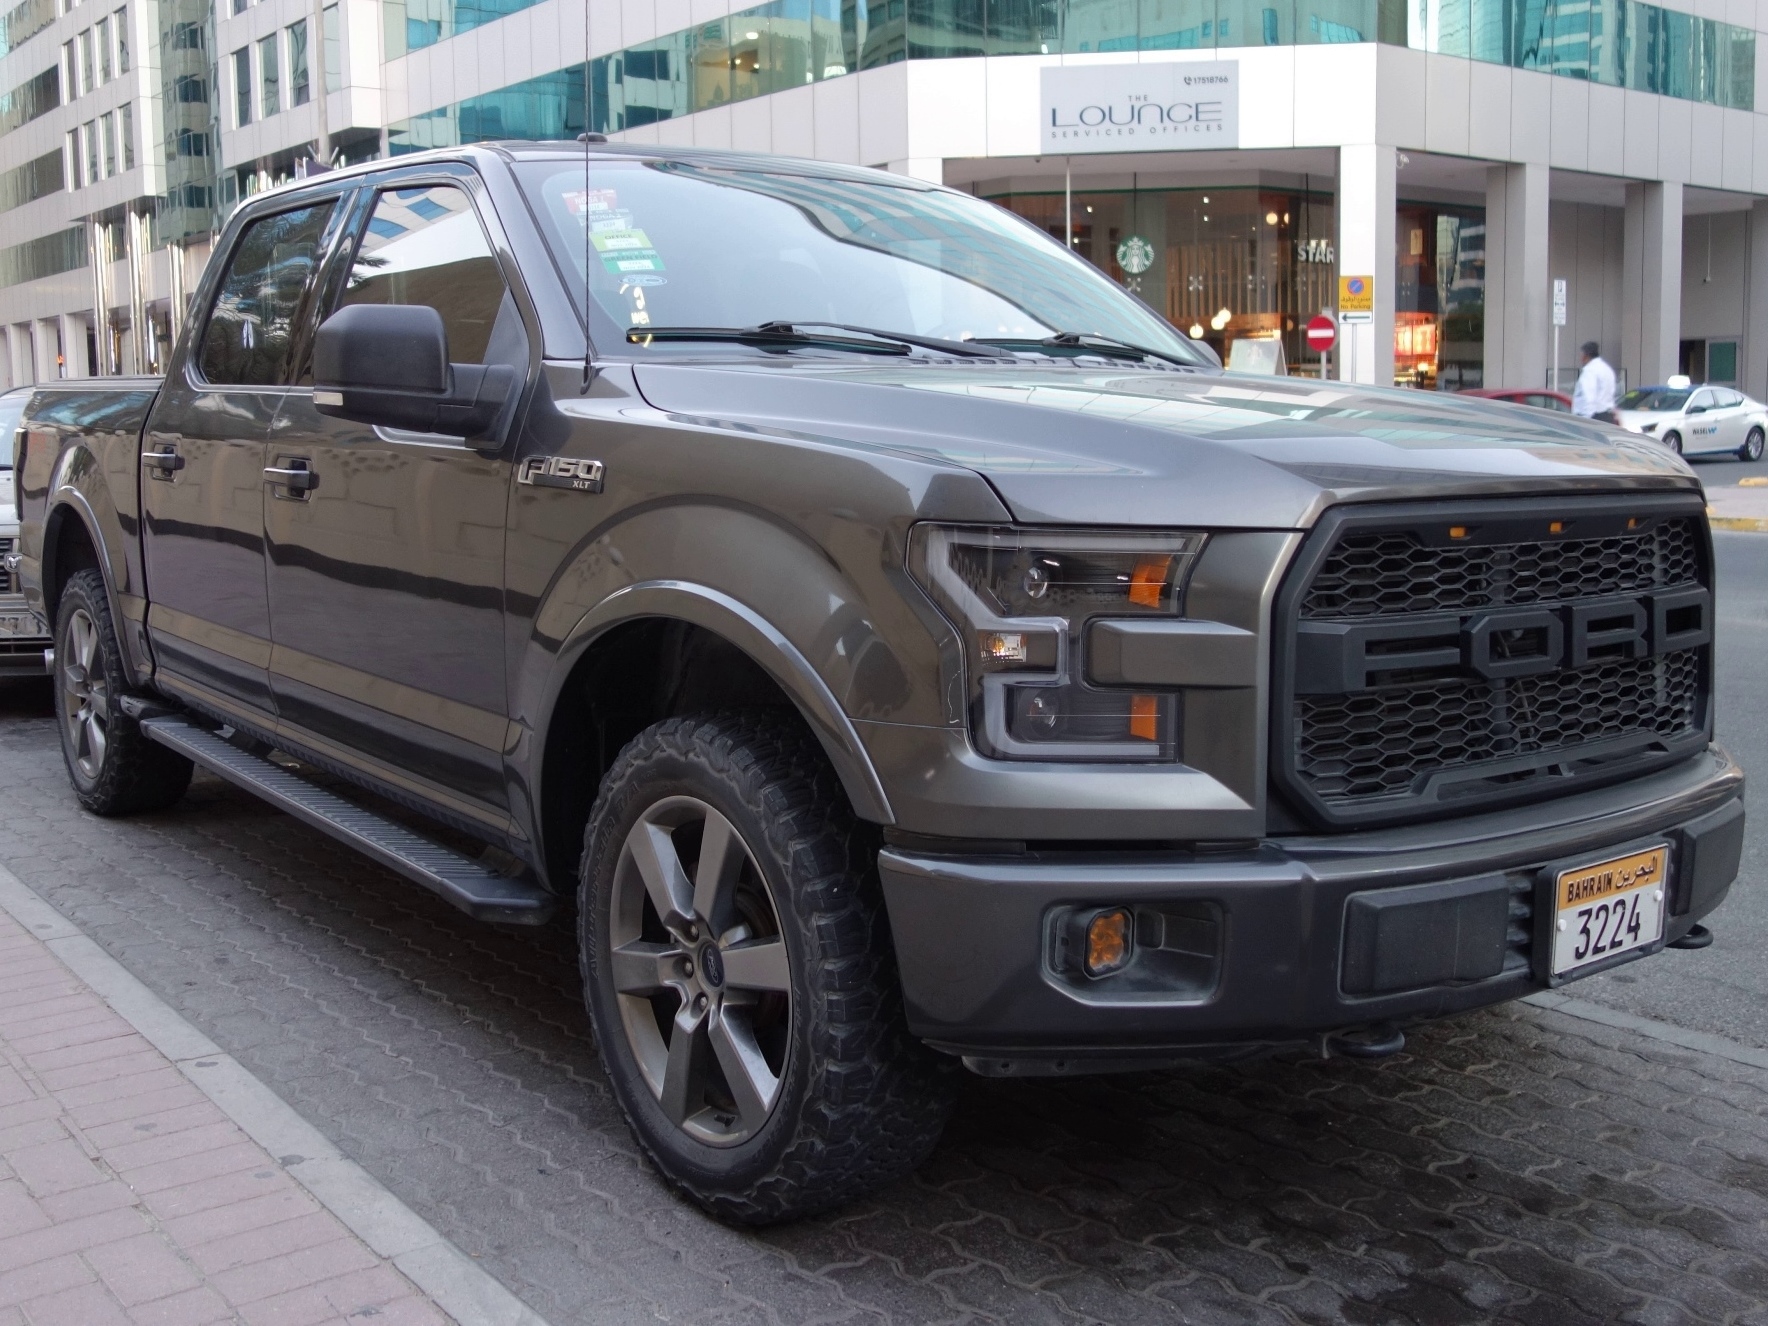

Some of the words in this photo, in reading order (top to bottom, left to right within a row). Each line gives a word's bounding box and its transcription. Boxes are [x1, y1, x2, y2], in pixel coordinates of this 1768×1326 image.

[1193, 76, 1229, 85] 17518766
[1128, 94, 1149, 102] THE
[1051, 101, 1223, 127] LOUNGE
[1051, 128, 1135, 139] SERVICED
[1149, 124, 1223, 134] OFFICES
[572, 480, 591, 489] XLT
[1340, 584, 1712, 694] FORD
[1615, 852, 1658, 890] البحرين
[1567, 869, 1614, 903] BAHRAIN
[1574, 892, 1641, 961] 3224
